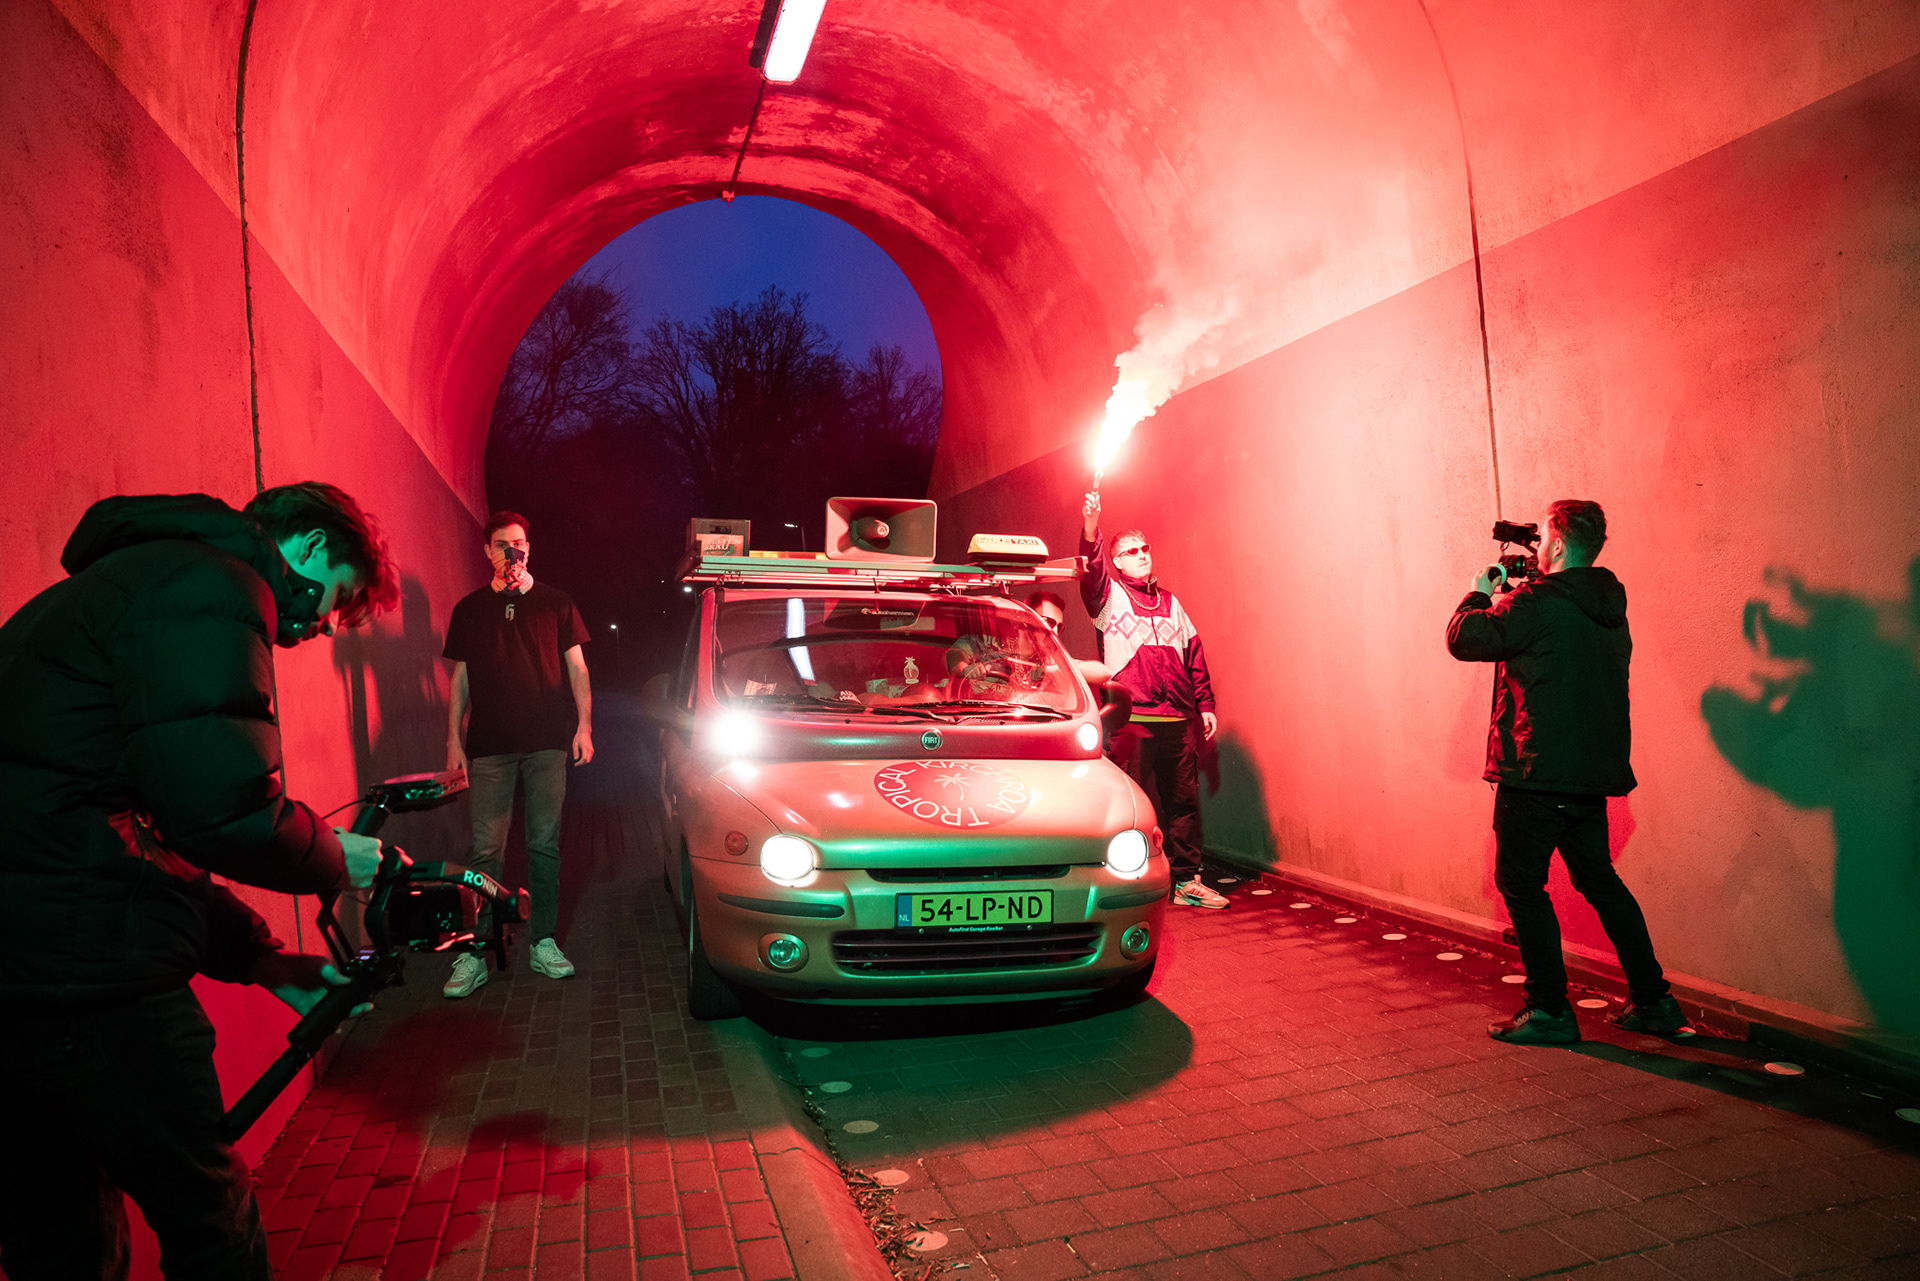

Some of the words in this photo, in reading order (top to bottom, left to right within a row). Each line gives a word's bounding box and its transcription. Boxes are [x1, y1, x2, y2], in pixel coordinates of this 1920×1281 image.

[924, 736, 938, 744] FIAT
[878, 767, 990, 827] TROPICAL
[463, 869, 498, 897] RONIN
[899, 914, 910, 923] NL
[920, 896, 1043, 922] 54-LP-ND
